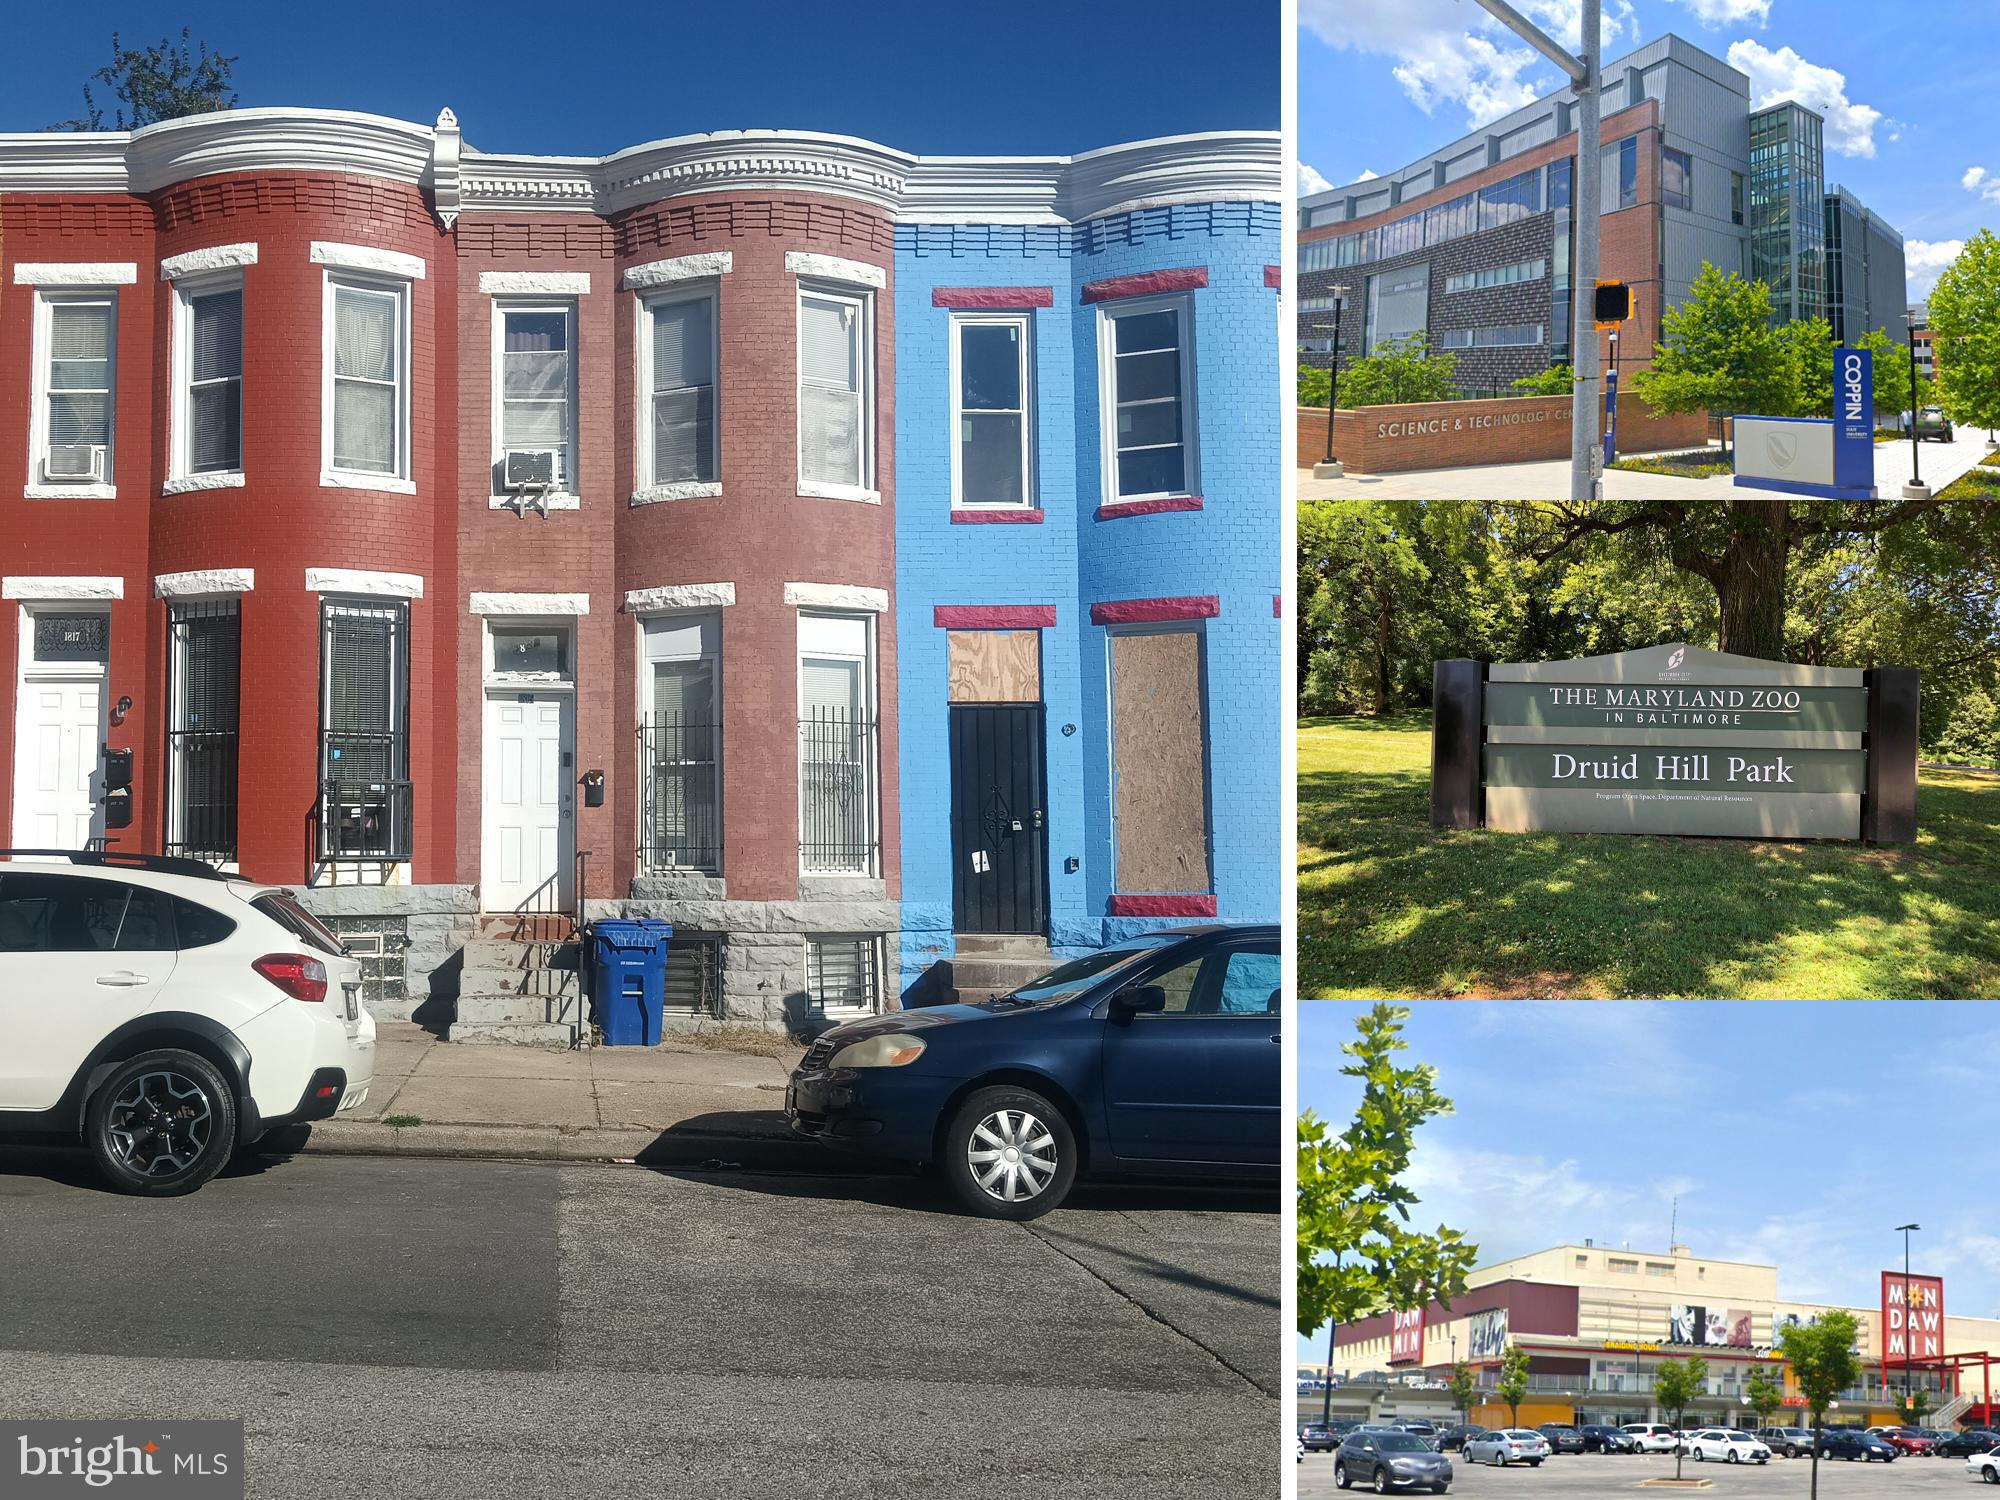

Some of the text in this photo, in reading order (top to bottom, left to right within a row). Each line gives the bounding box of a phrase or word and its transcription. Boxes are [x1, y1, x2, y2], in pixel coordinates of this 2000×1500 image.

[1844, 354, 1862, 420] COPPIN
[1378, 419, 1448, 438] SCIENCE
[1454, 418, 1462, 431] &
[1469, 410, 1550, 429] TECHNOLOGY
[64, 631, 81, 642] 1817
[1550, 687, 1801, 708] THE MARYLAND ZOO
[1606, 712, 1741, 725] IN BALTIMORE
[1552, 753, 1795, 783] Druid Hill Park
[1596, 792, 1620, 801] Program
[1622, 793, 1638, 801] Open
[1658, 793, 1693, 802] Department
[1701, 794, 1723, 802] Natural
[1724, 795, 1753, 803] Resources
[1890, 1308, 1939, 1332] DAW
[1393, 1330, 1419, 1355] MIN
[1888, 1333, 1938, 1357] MIN
